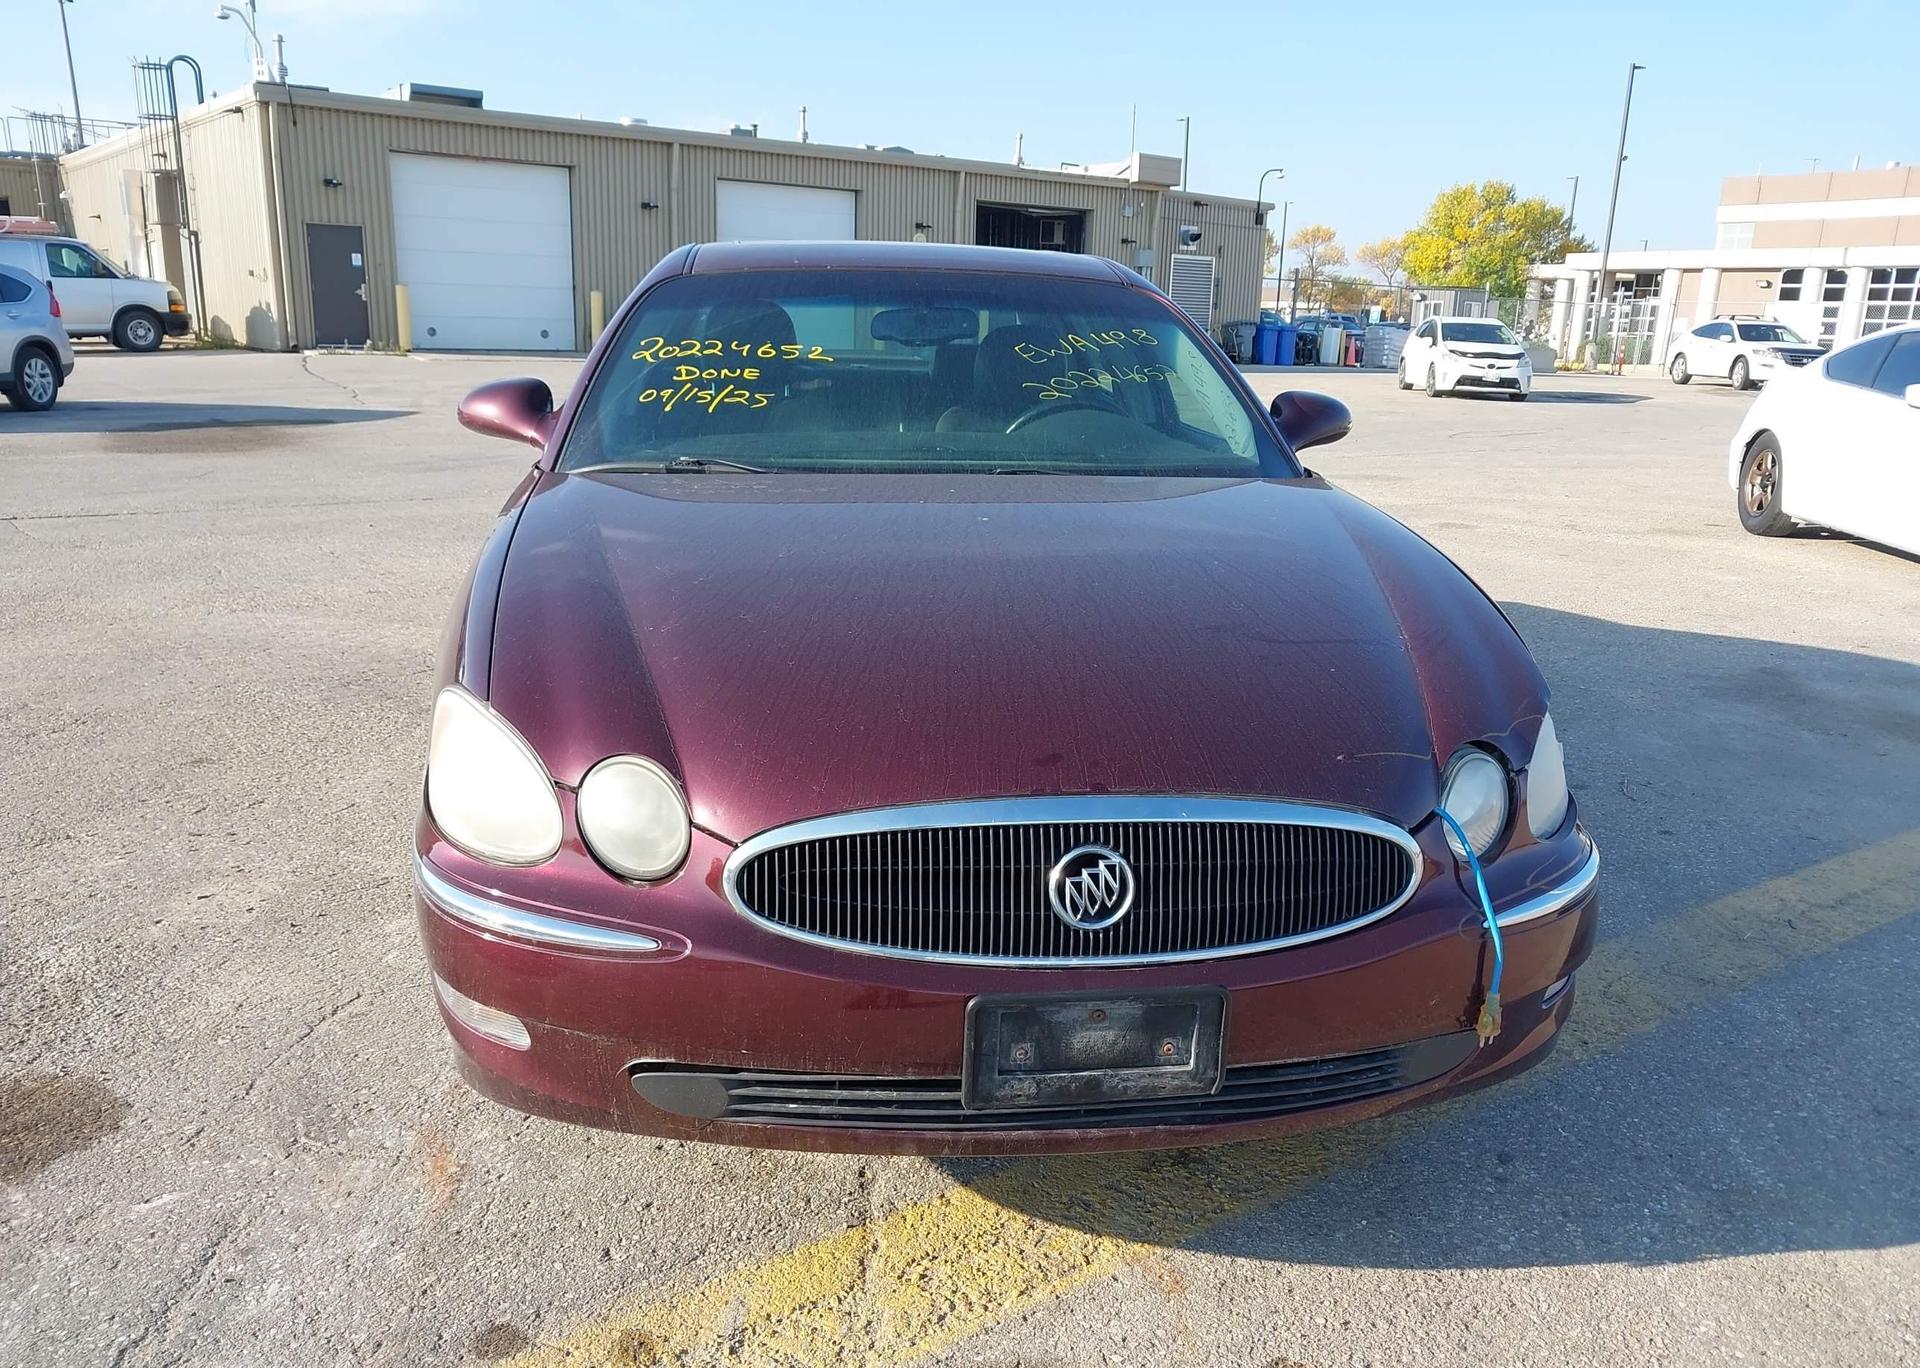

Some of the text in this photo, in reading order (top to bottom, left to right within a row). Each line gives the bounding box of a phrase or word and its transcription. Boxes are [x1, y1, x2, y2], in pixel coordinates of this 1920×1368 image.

[632, 336, 835, 363] 20224652
[1014, 329, 1159, 364] EWA498
[672, 365, 761, 381] DONE
[638, 383, 776, 413] 09/15/25
